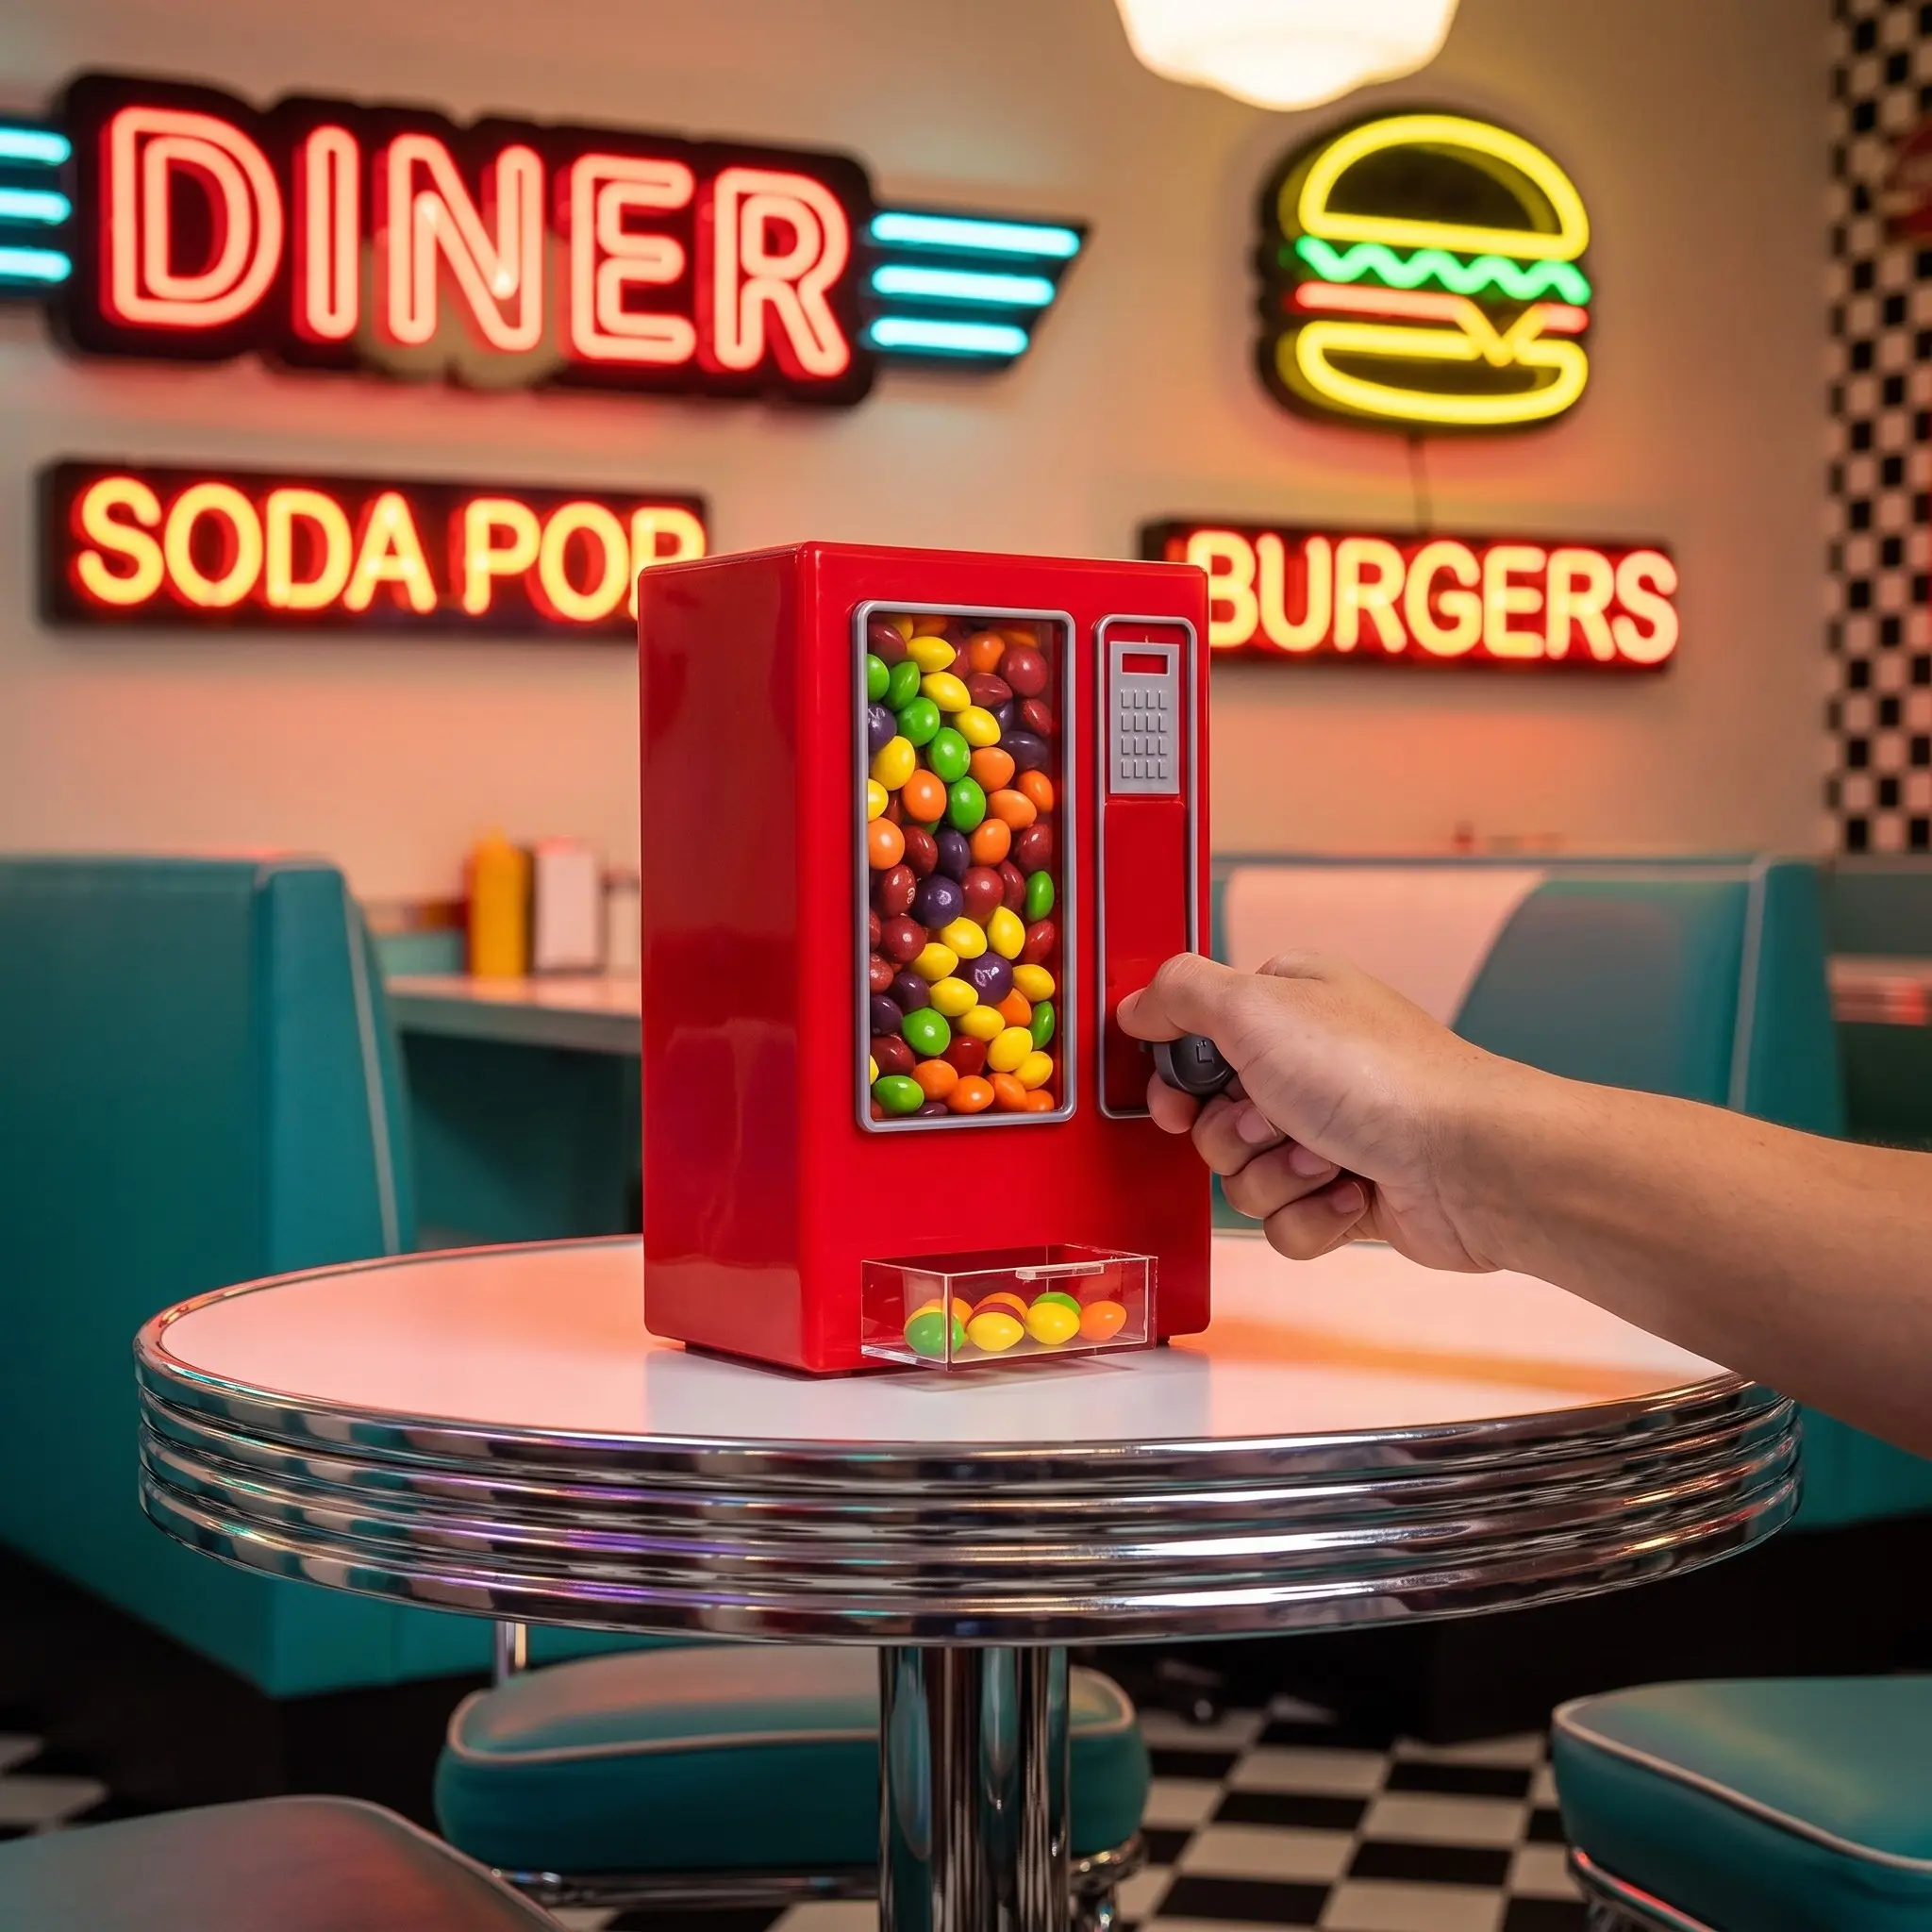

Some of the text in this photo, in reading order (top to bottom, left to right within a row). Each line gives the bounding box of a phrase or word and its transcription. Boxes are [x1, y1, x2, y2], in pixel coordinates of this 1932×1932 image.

[109, 105, 850, 377] DINER
[77, 476, 707, 623] SODA POP
[1185, 528, 1679, 663] BURGERS
